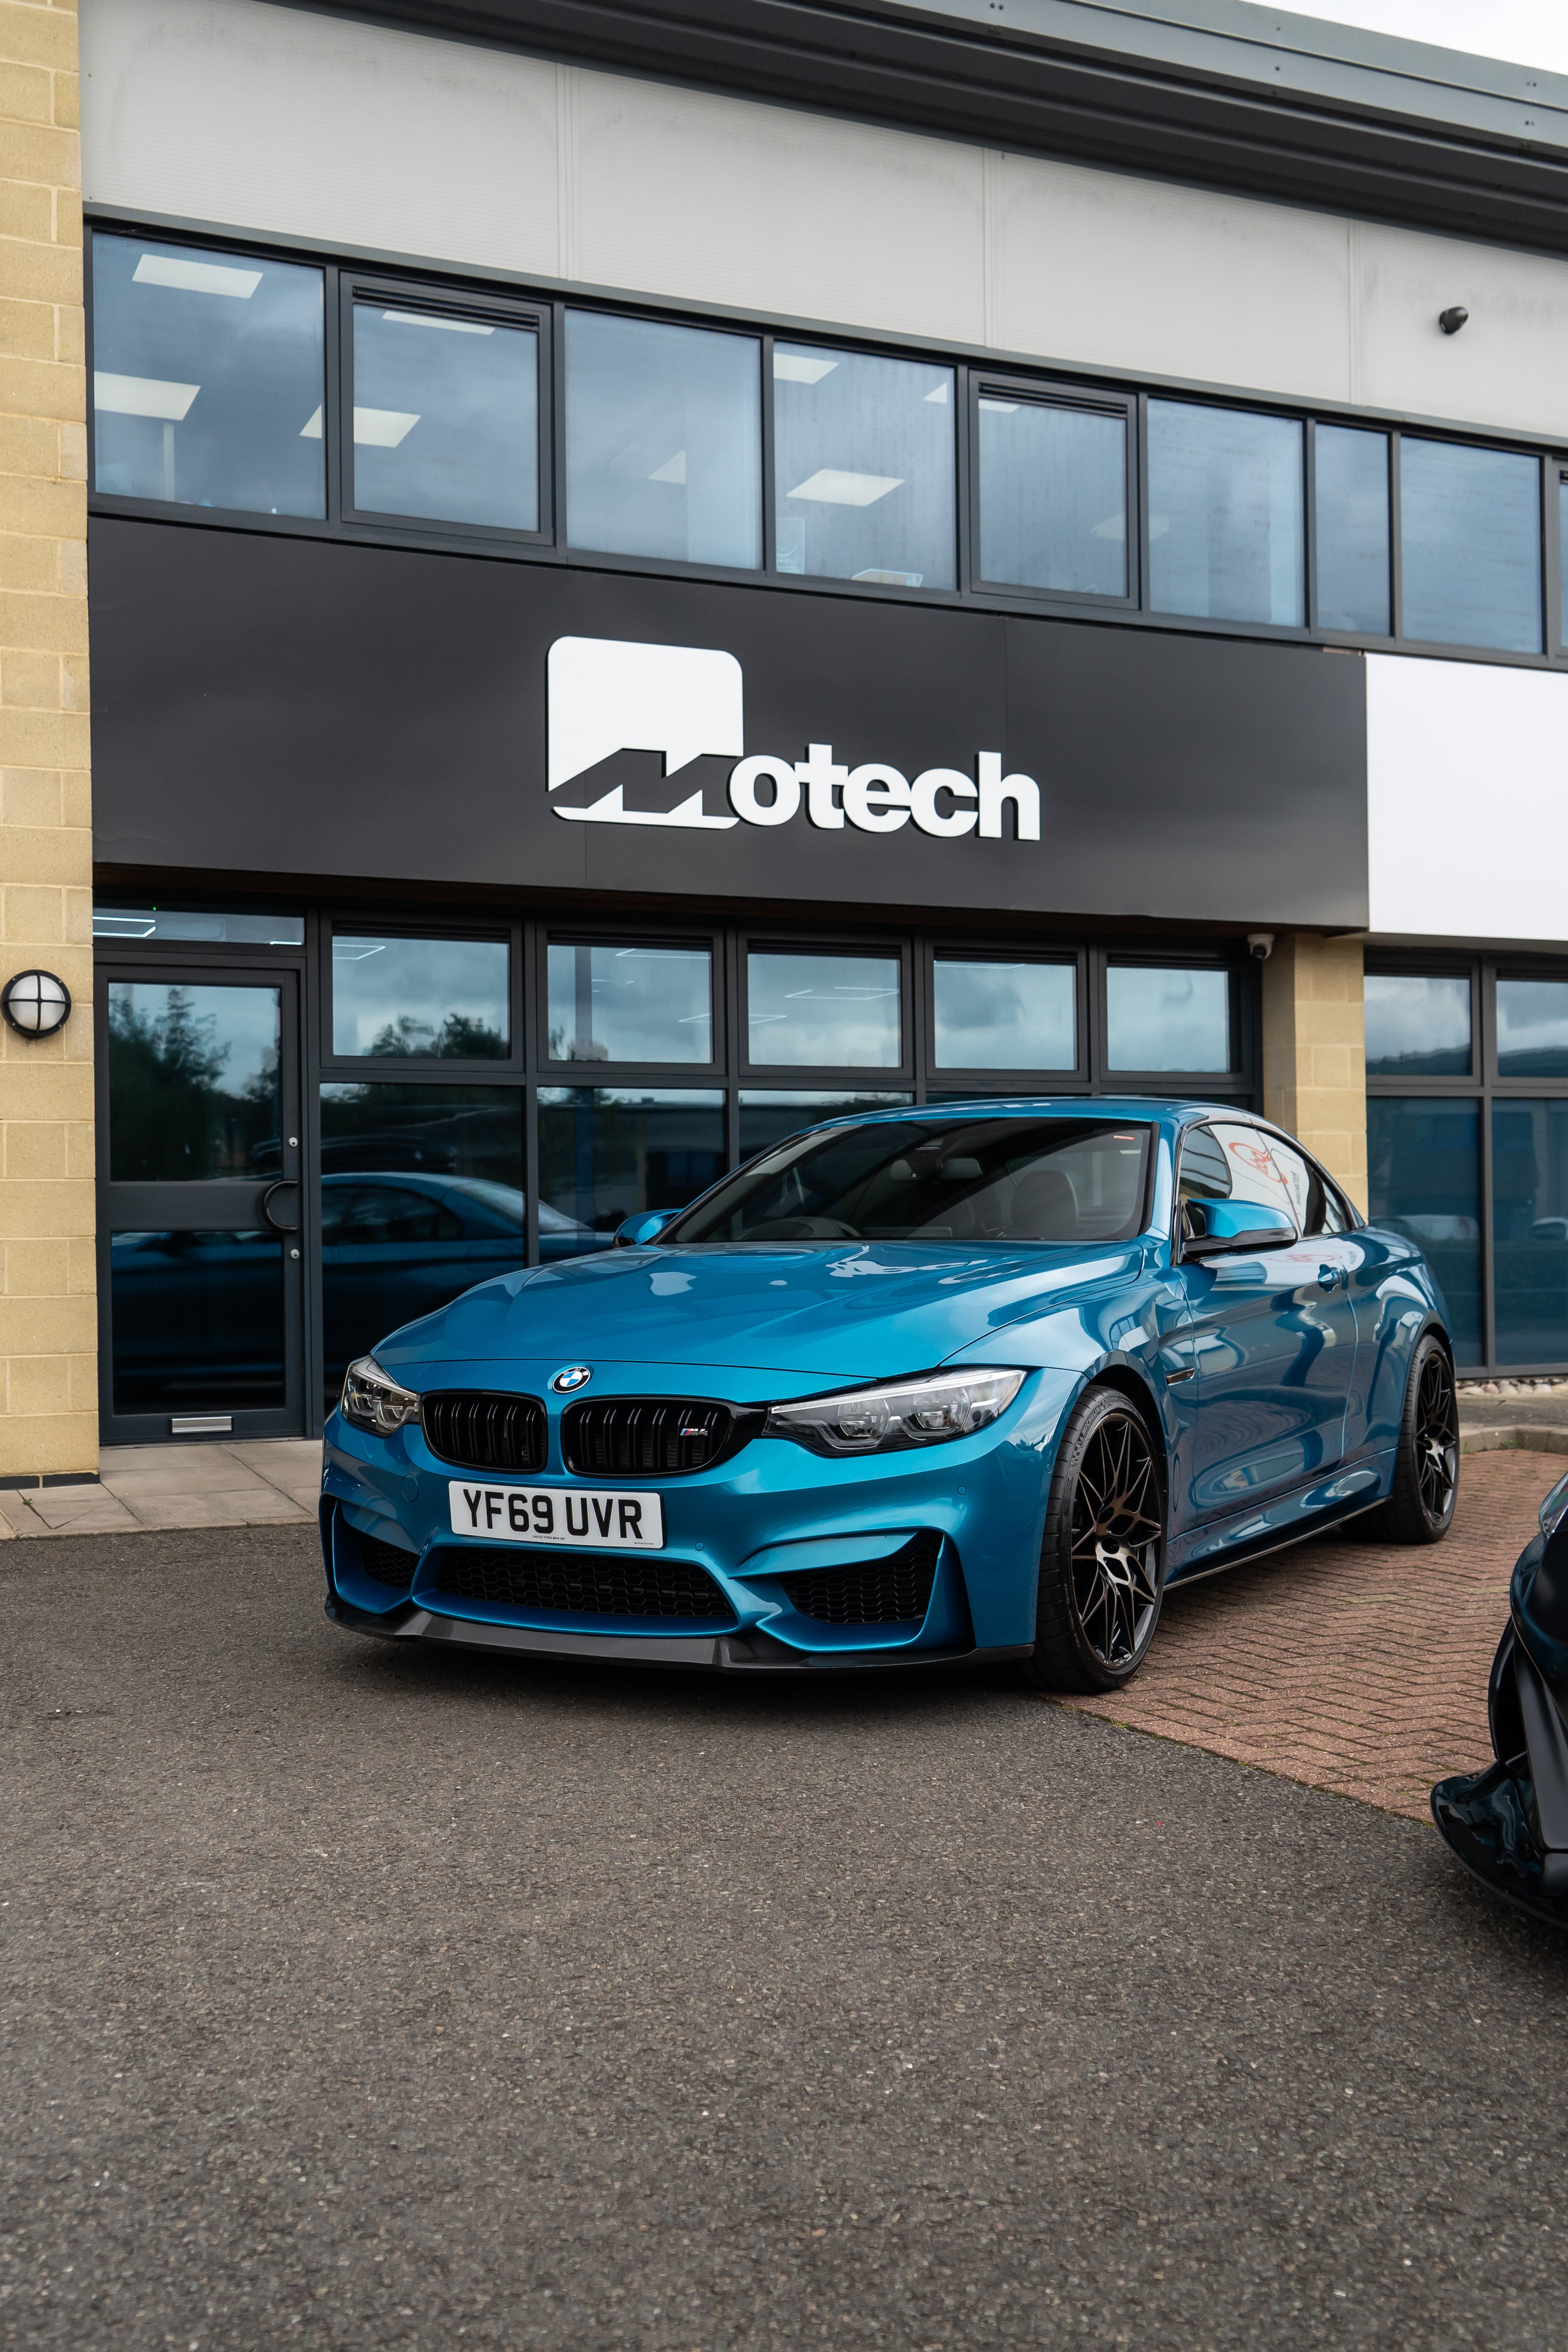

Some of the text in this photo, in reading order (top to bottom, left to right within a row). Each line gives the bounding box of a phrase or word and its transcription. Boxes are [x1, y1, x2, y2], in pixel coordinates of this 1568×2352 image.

[1082, 1404, 1103, 1437] MICHELIN
[463, 1489, 643, 1539] YF69 UVR
